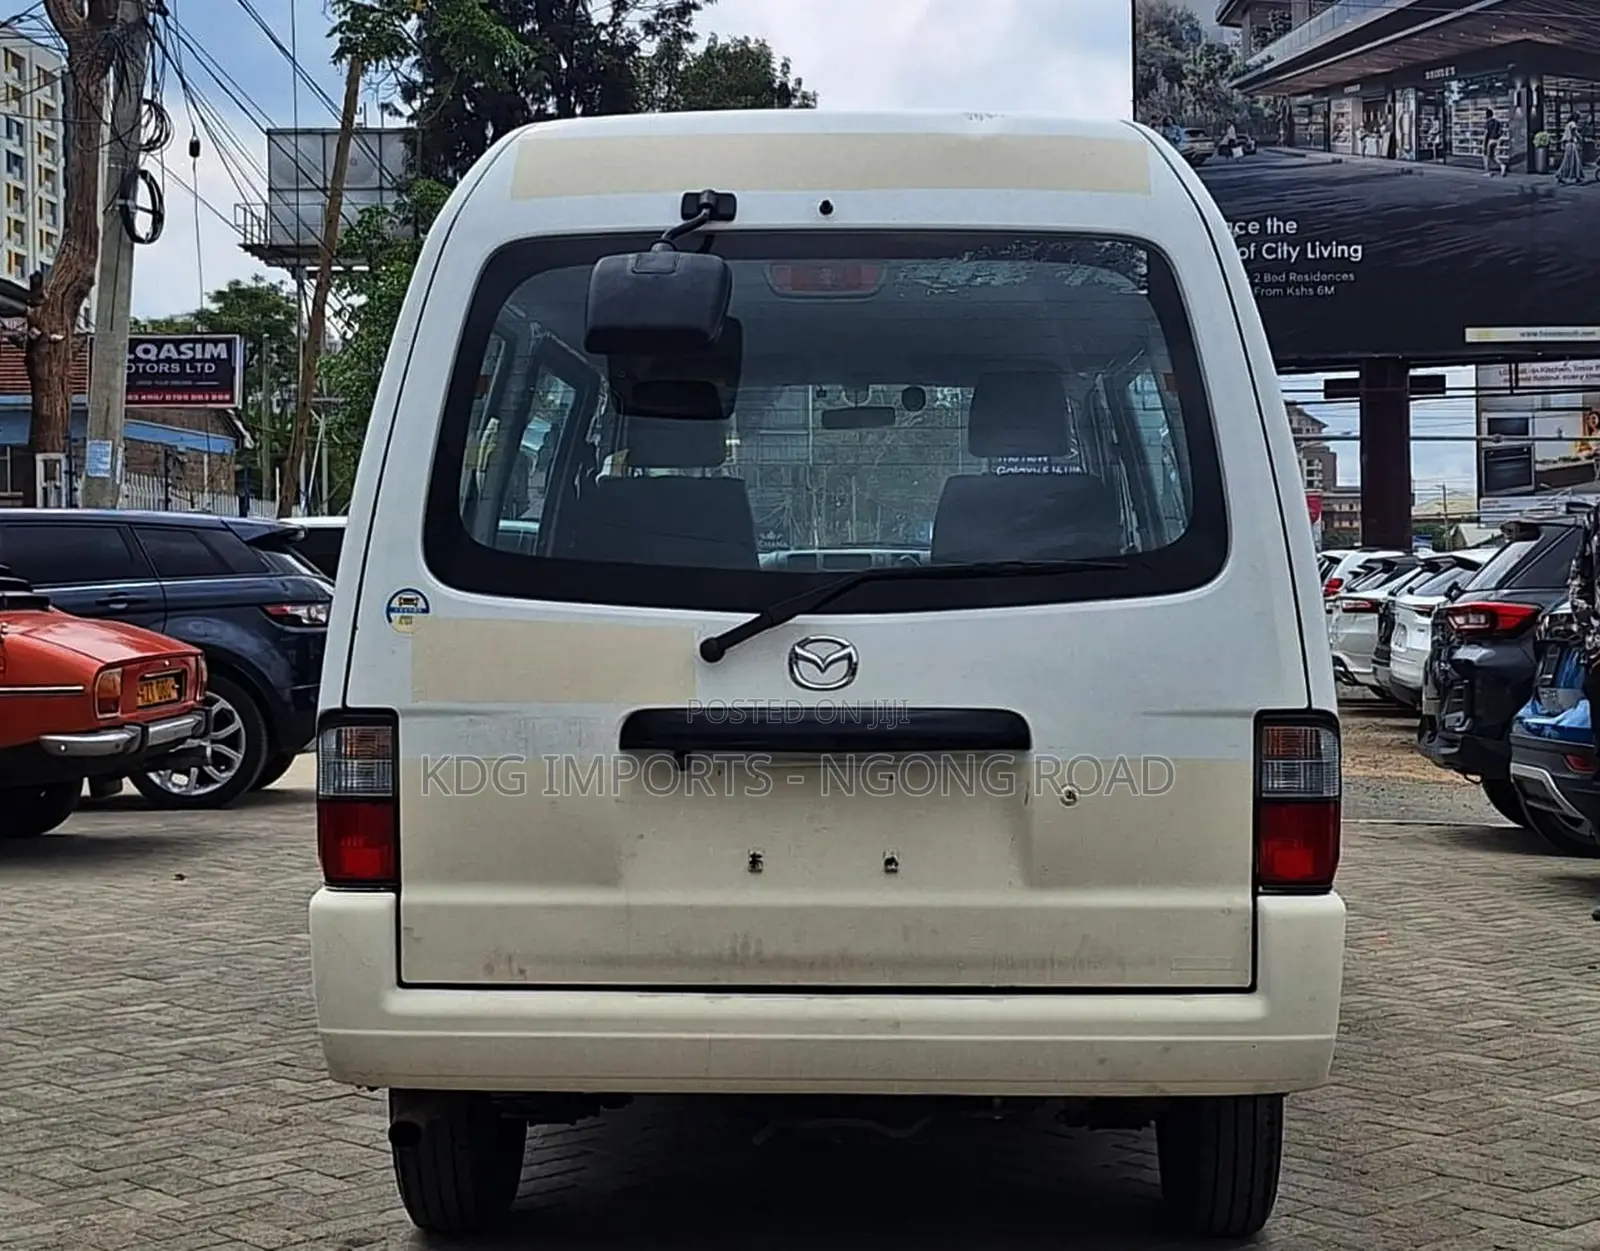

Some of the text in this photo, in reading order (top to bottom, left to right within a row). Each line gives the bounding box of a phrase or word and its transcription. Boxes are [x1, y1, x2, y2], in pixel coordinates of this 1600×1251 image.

[1266, 216, 1298, 234] the
[1238, 240, 1362, 263] of City Living
[1254, 270, 1355, 283] 2 Bed Residences
[1254, 285, 1336, 297] From Kshs 6M
[185, 362, 216, 374] LTD
